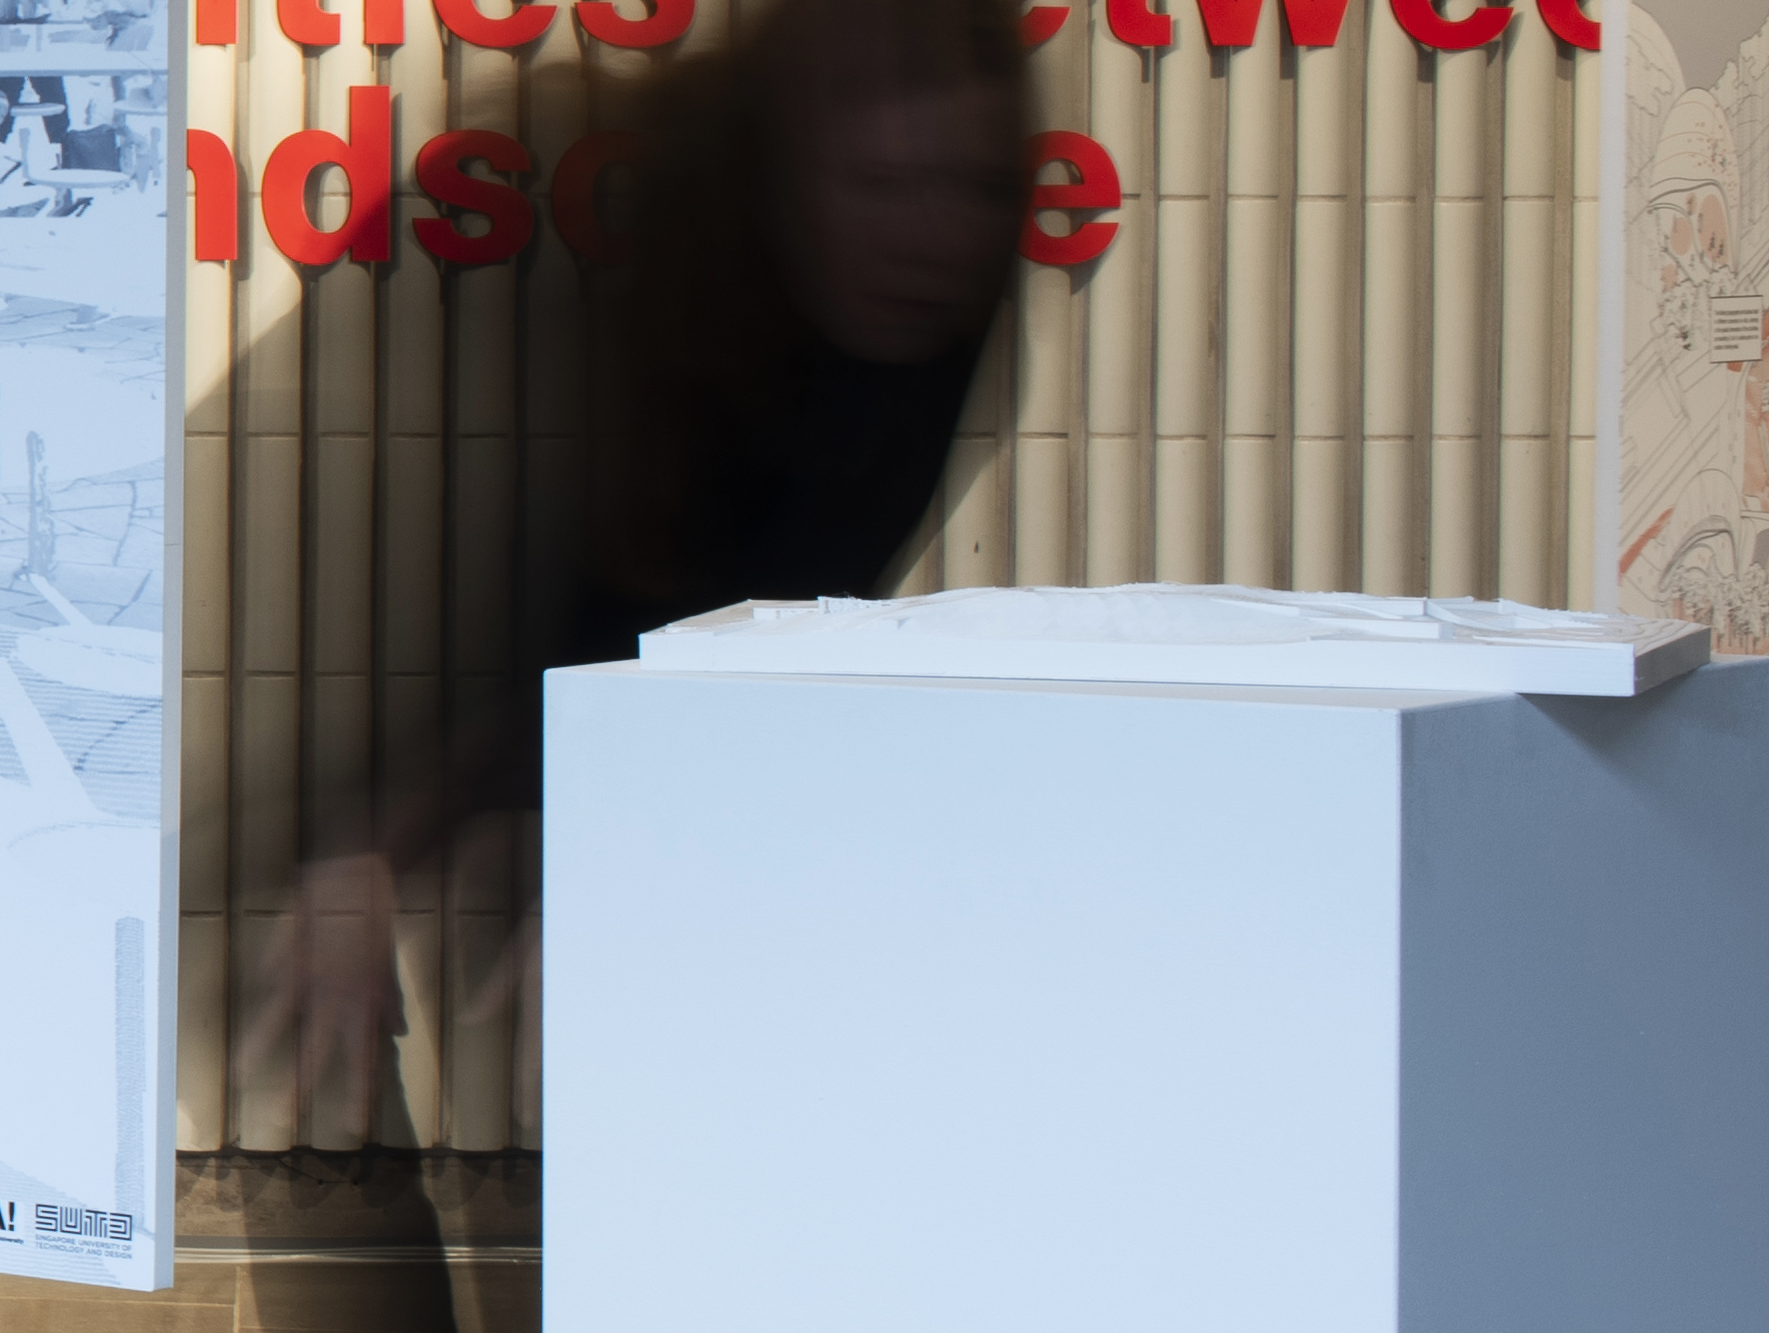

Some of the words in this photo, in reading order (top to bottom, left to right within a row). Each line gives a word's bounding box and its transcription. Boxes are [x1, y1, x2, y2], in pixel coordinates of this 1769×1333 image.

[35, 1234, 76, 1245] SINGAPORE
[78, 1239, 120, 1250] UNIVERSITY
[35, 1242, 84, 1253] TECHNOLOGY
[86, 1248, 103, 1256] AND
[104, 1250, 132, 1259] DESIGN
